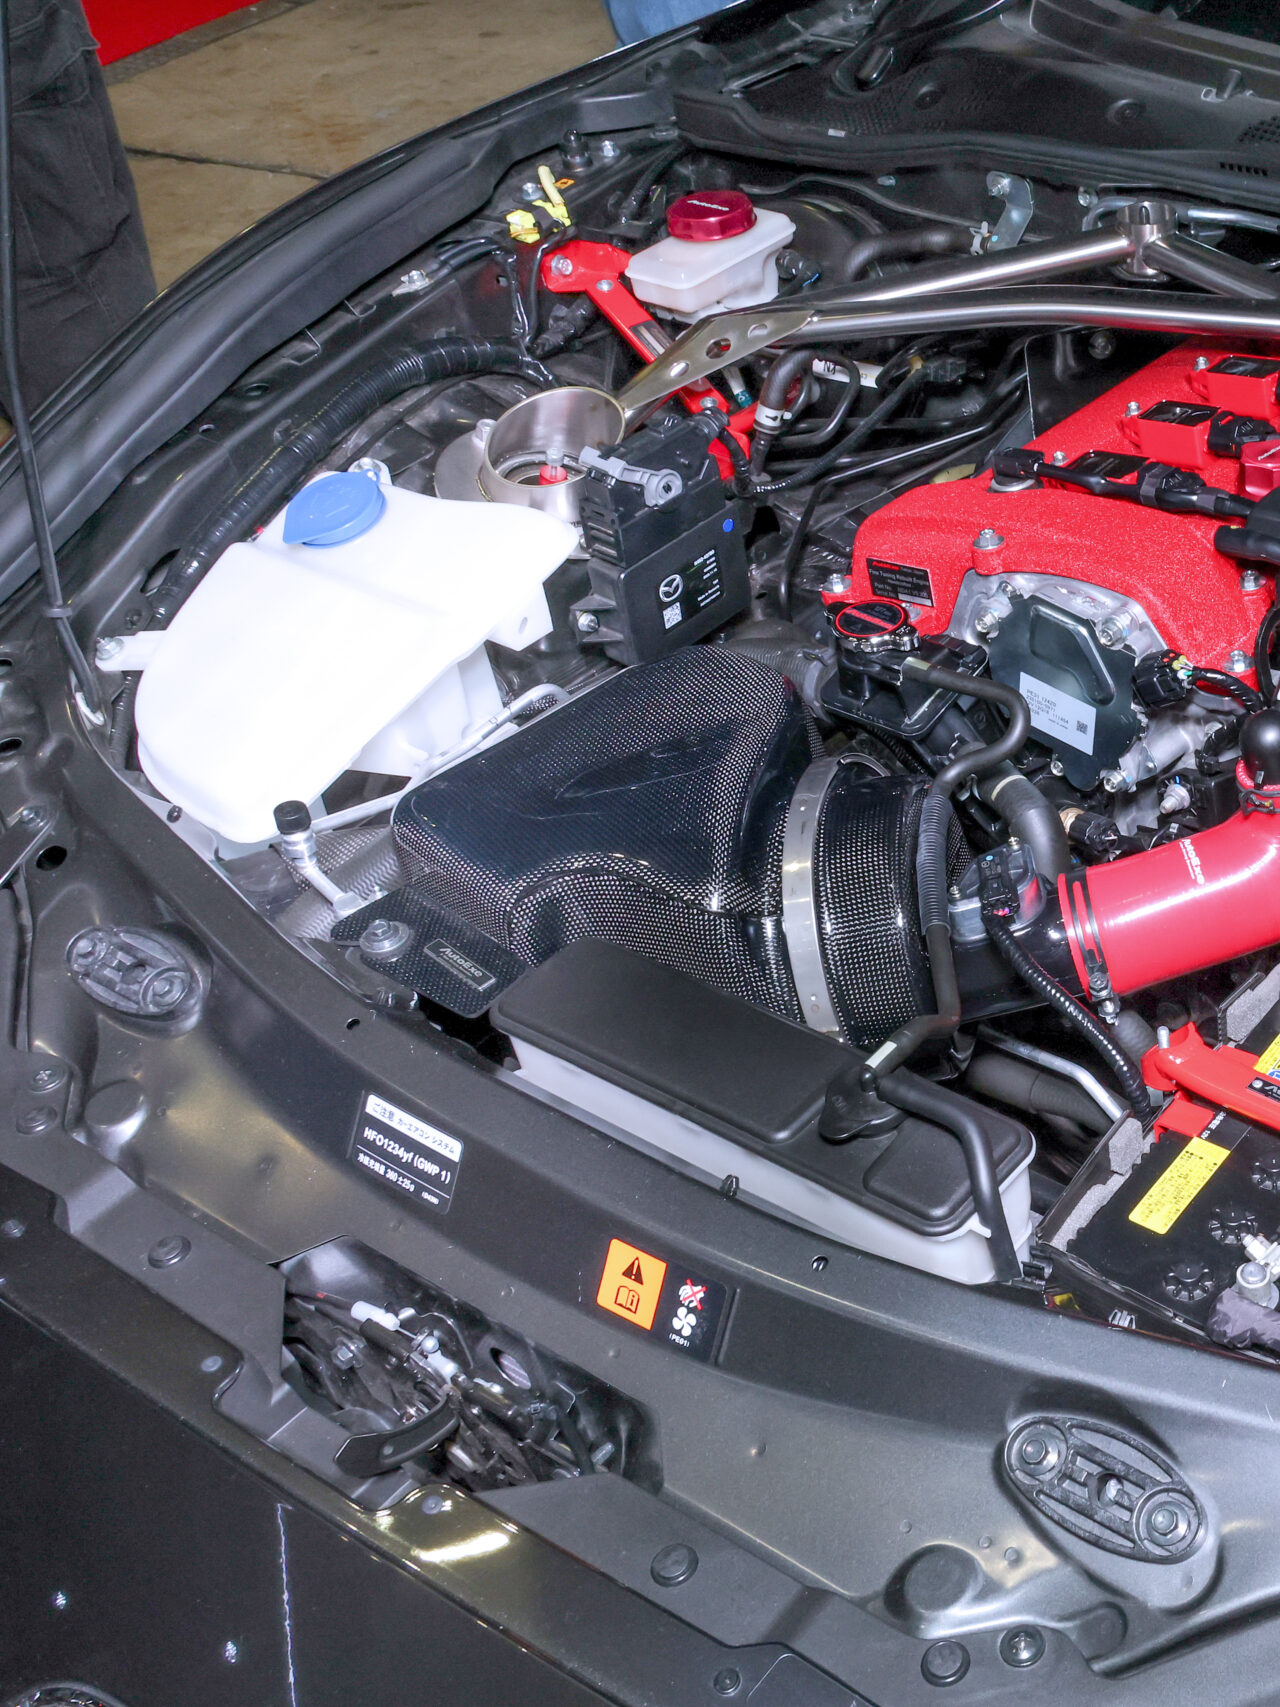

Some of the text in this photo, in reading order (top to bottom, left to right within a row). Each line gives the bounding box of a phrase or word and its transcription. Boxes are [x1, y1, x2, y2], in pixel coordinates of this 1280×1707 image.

[440, 948, 483, 977] AutoExe
[372, 1102, 395, 1122] ご注意
[363, 1126, 451, 1185] HFO1234yf (GWP 1)
